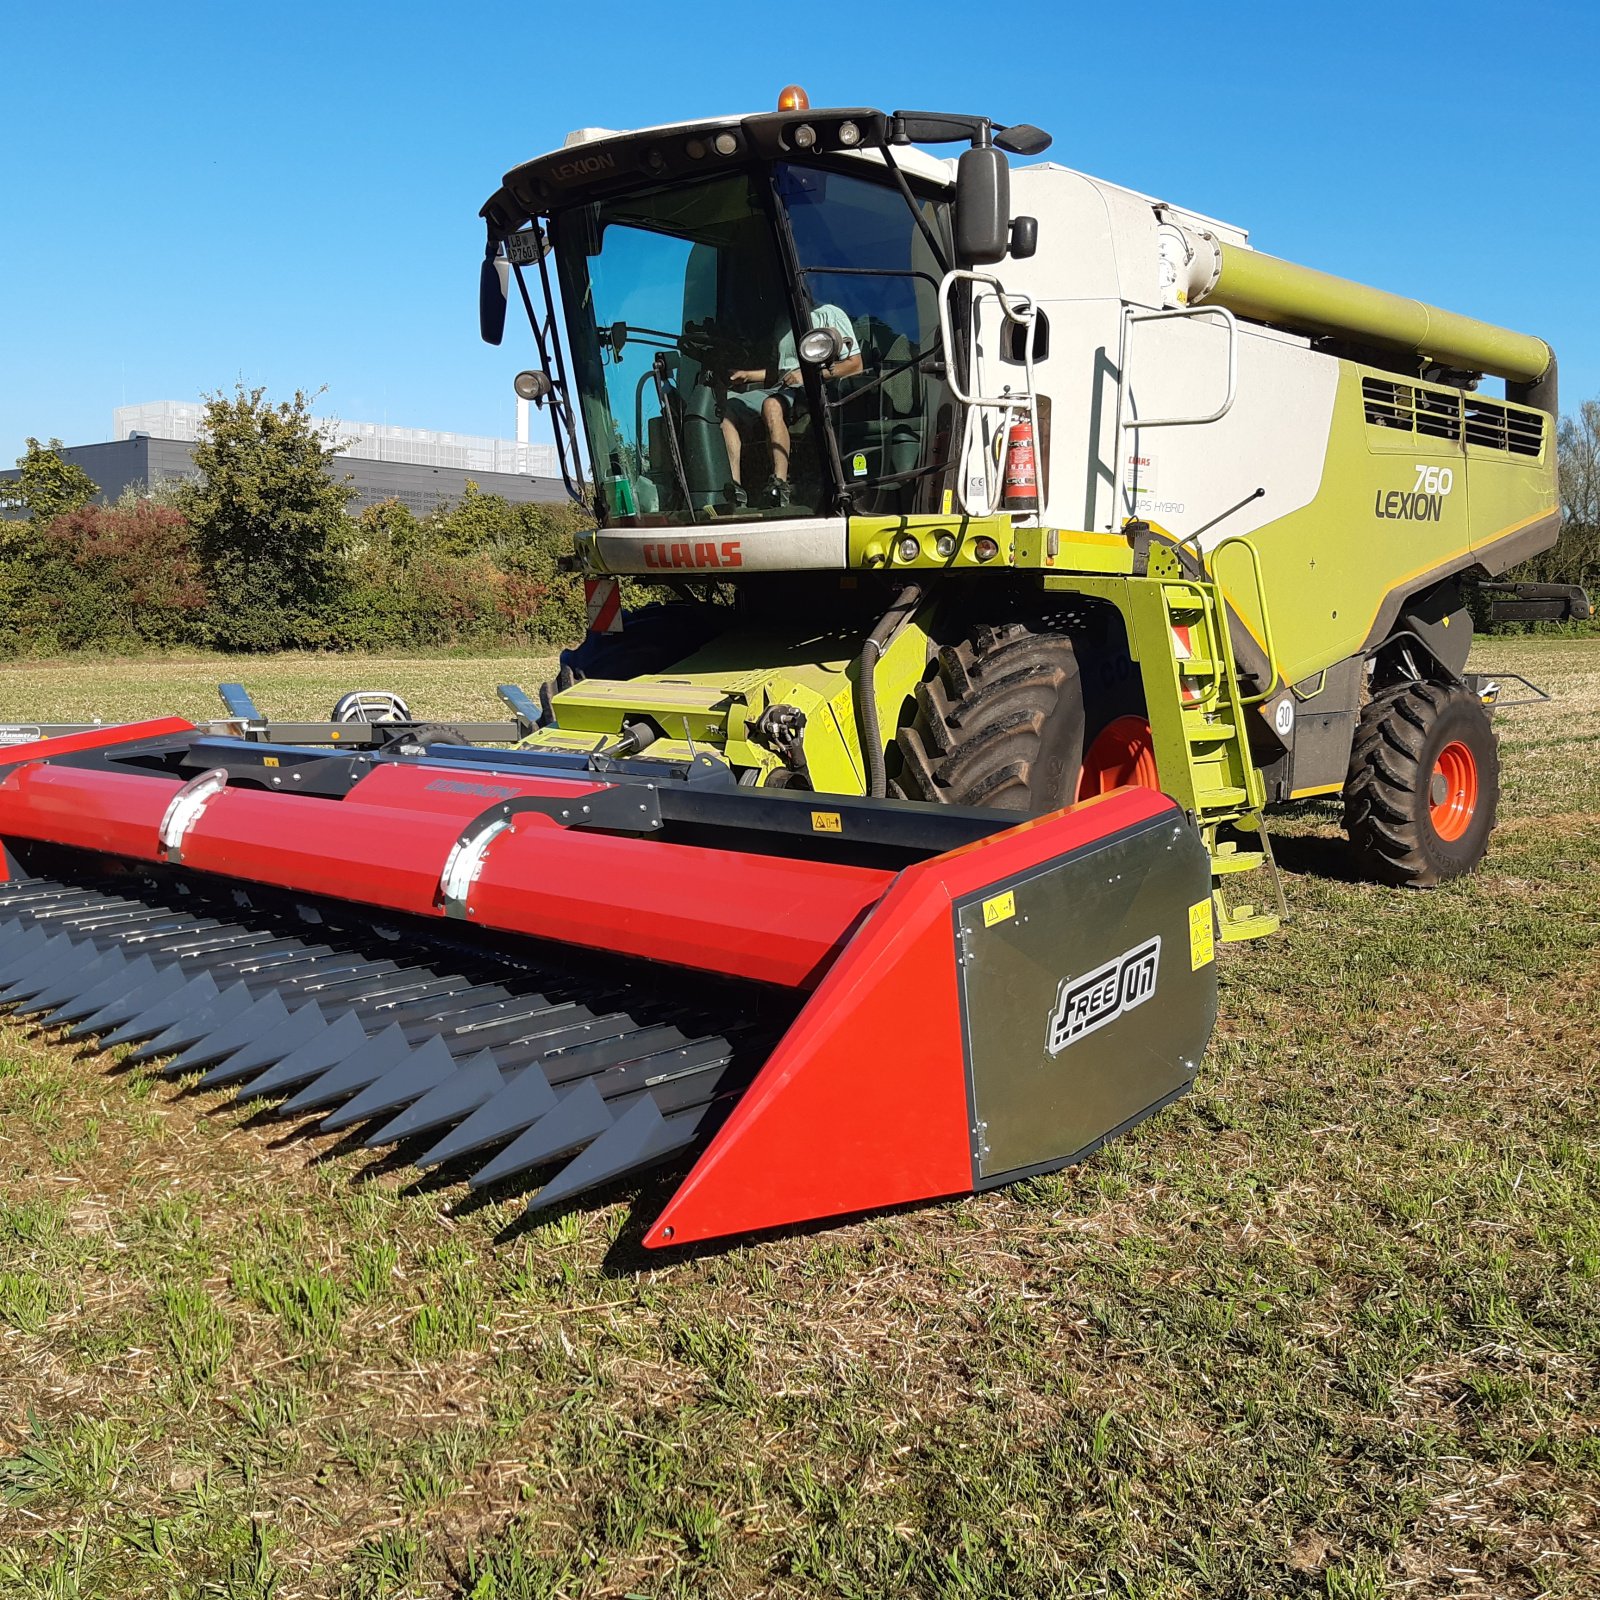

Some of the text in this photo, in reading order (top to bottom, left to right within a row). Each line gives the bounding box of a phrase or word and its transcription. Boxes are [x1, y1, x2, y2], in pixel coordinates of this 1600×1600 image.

[551, 152, 616, 181] LEXION
[510, 235, 522, 248] LB
[1128, 455, 1151, 467] CLAAS
[1413, 464, 1453, 495] 760
[1375, 489, 1443, 522] LEXION
[643, 541, 743, 569] CLAAS
[1278, 706, 1291, 728] 30
